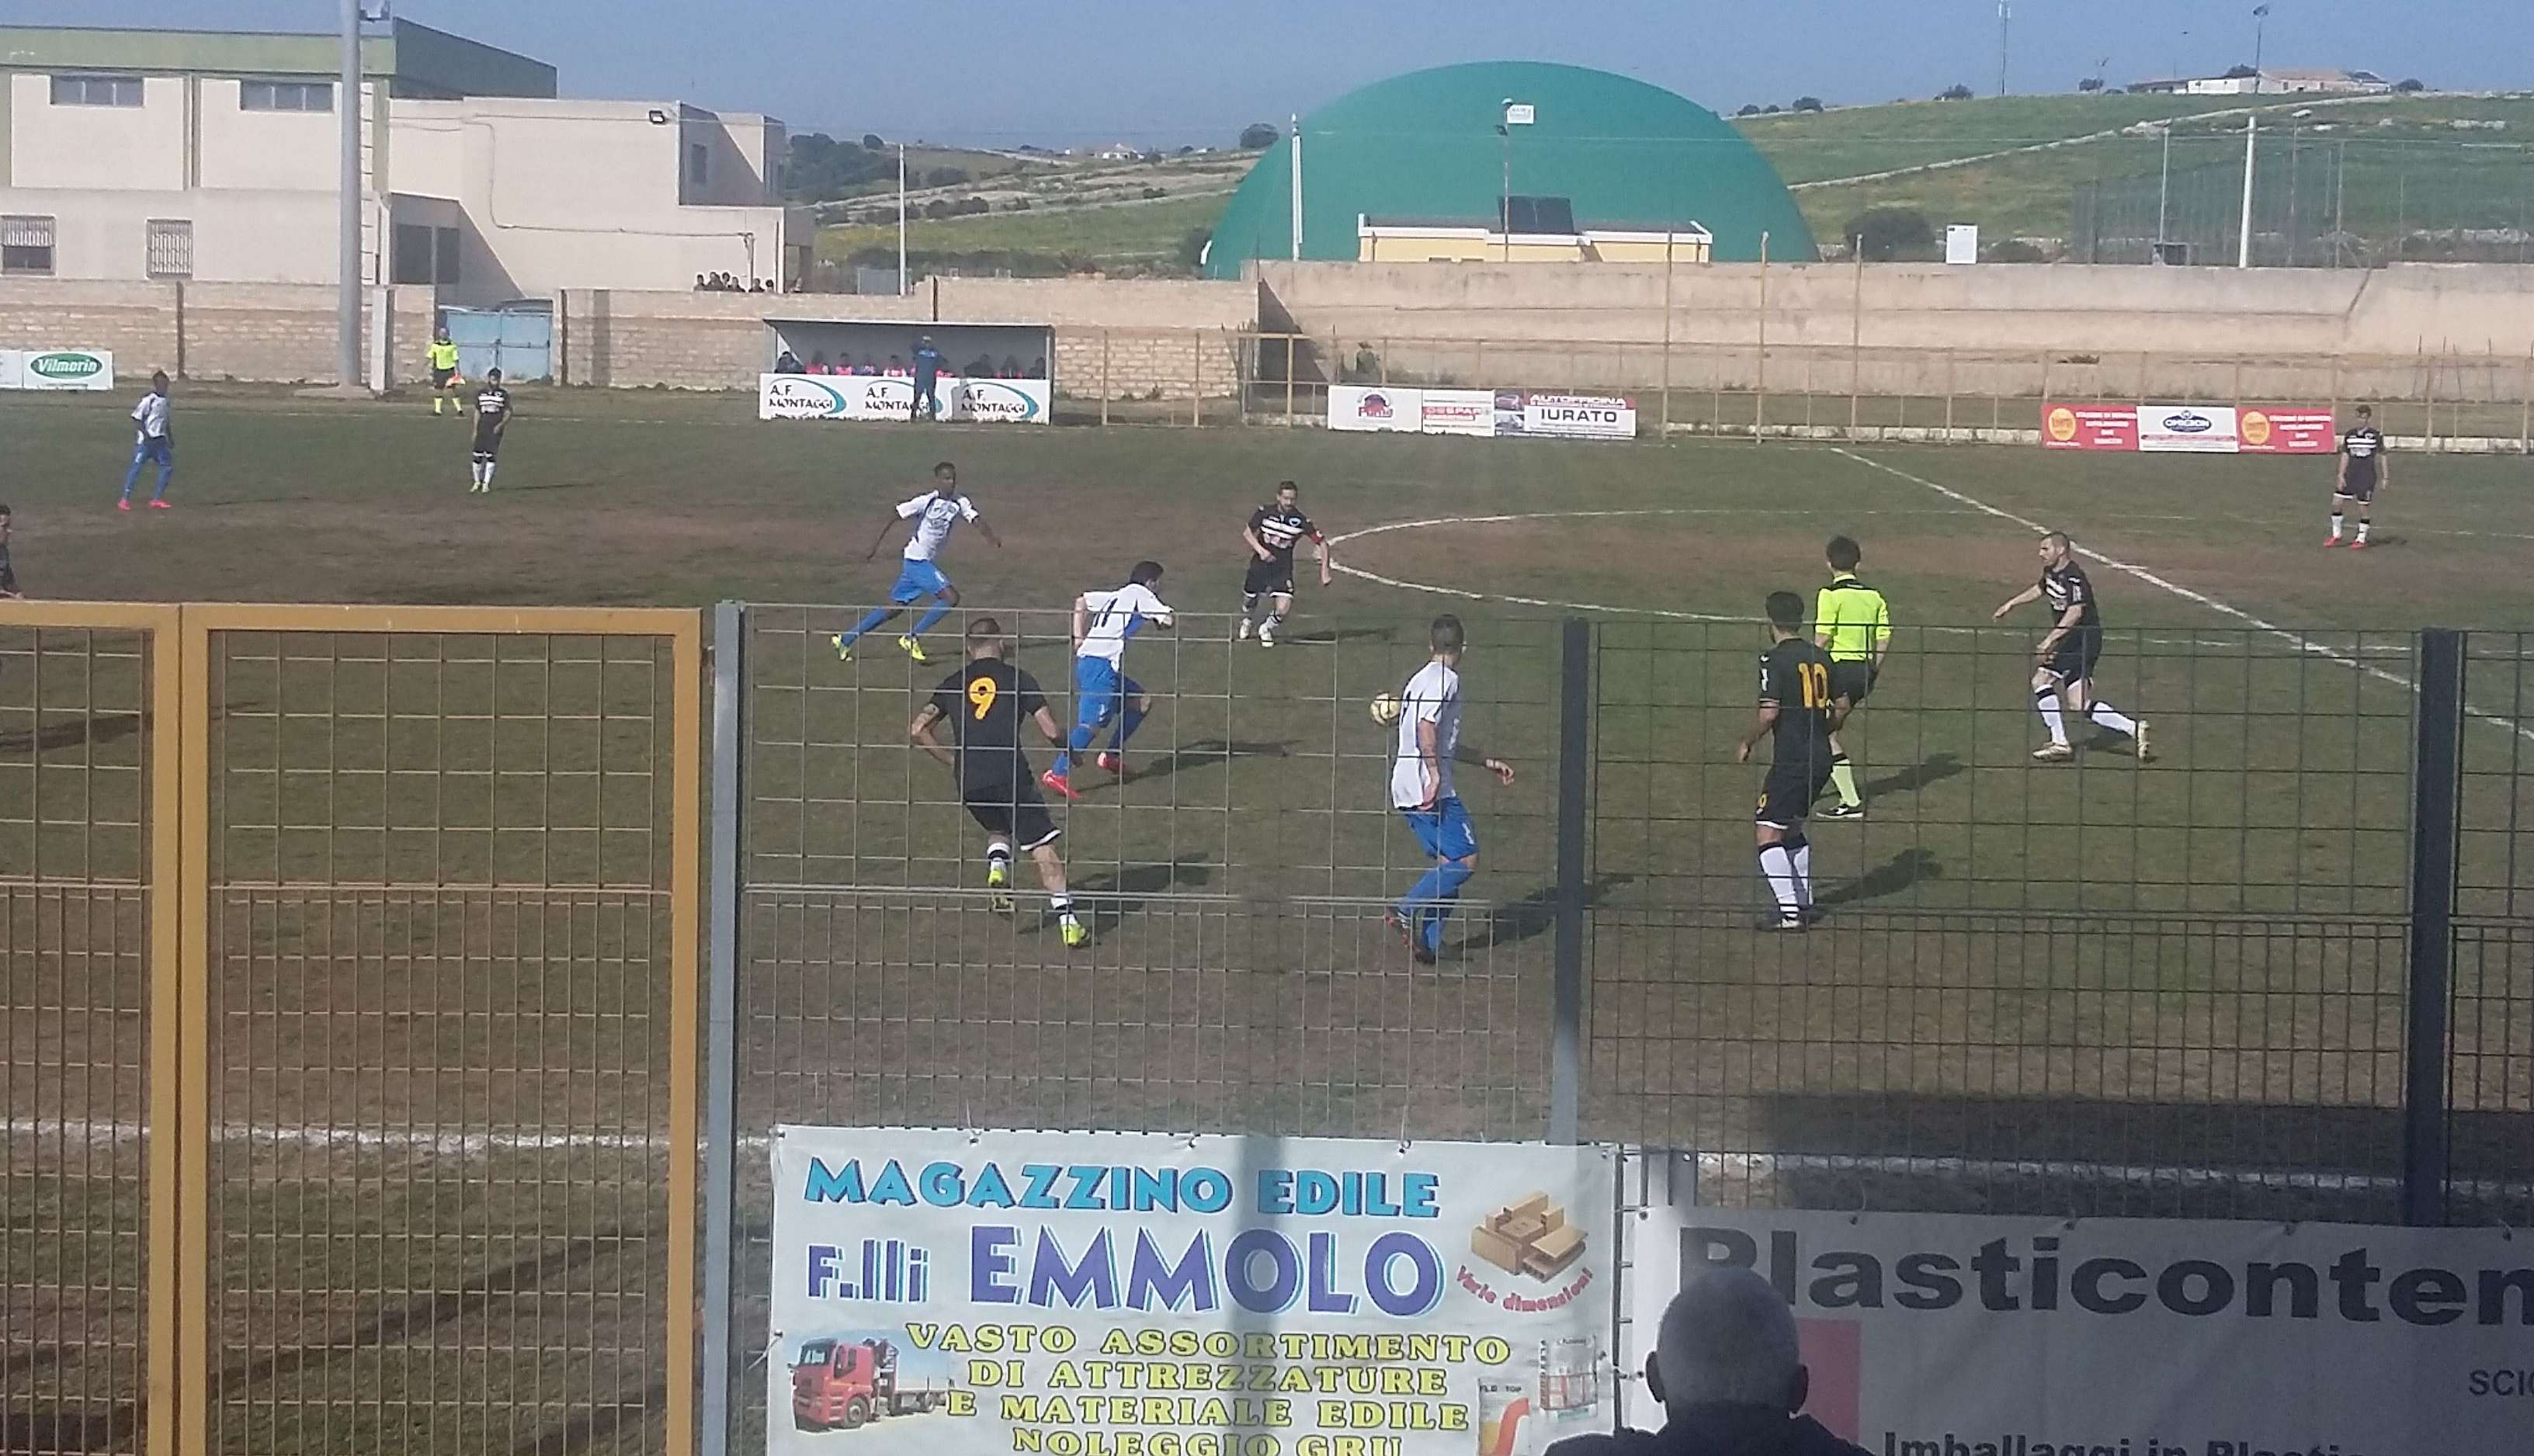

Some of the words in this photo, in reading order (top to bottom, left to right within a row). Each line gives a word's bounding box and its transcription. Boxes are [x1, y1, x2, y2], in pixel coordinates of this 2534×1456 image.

[38, 359, 97, 373] Vilmorin
[769, 398, 833, 409] MONTAGGI
[961, 403, 1026, 413] MONTAGGI
[1541, 408, 1617, 423] IURATO
[969, 676, 997, 720] 9
[1798, 662, 1828, 708] 10
[804, 1156, 1234, 1214] MAGAZZINO
[1257, 1169, 1440, 1218] EDILE
[970, 1223, 1446, 1316] EMMOLO
[1456, 1264, 1497, 1304] Varie
[906, 1323, 1077, 1354] VASTO
[1101, 1328, 1511, 1365] ASSORTIMENTO
[969, 1359, 1025, 1388] DI
[1047, 1360, 1448, 1396] ATTREZZATURE
[947, 1390, 977, 1416] E
[1001, 1395, 1293, 1427] MATERIALE
[1317, 1400, 1469, 1431] EDILE
[1012, 1428, 1281, 1456] NOLEGGIO
[1296, 1434, 1403, 1456] GRU
